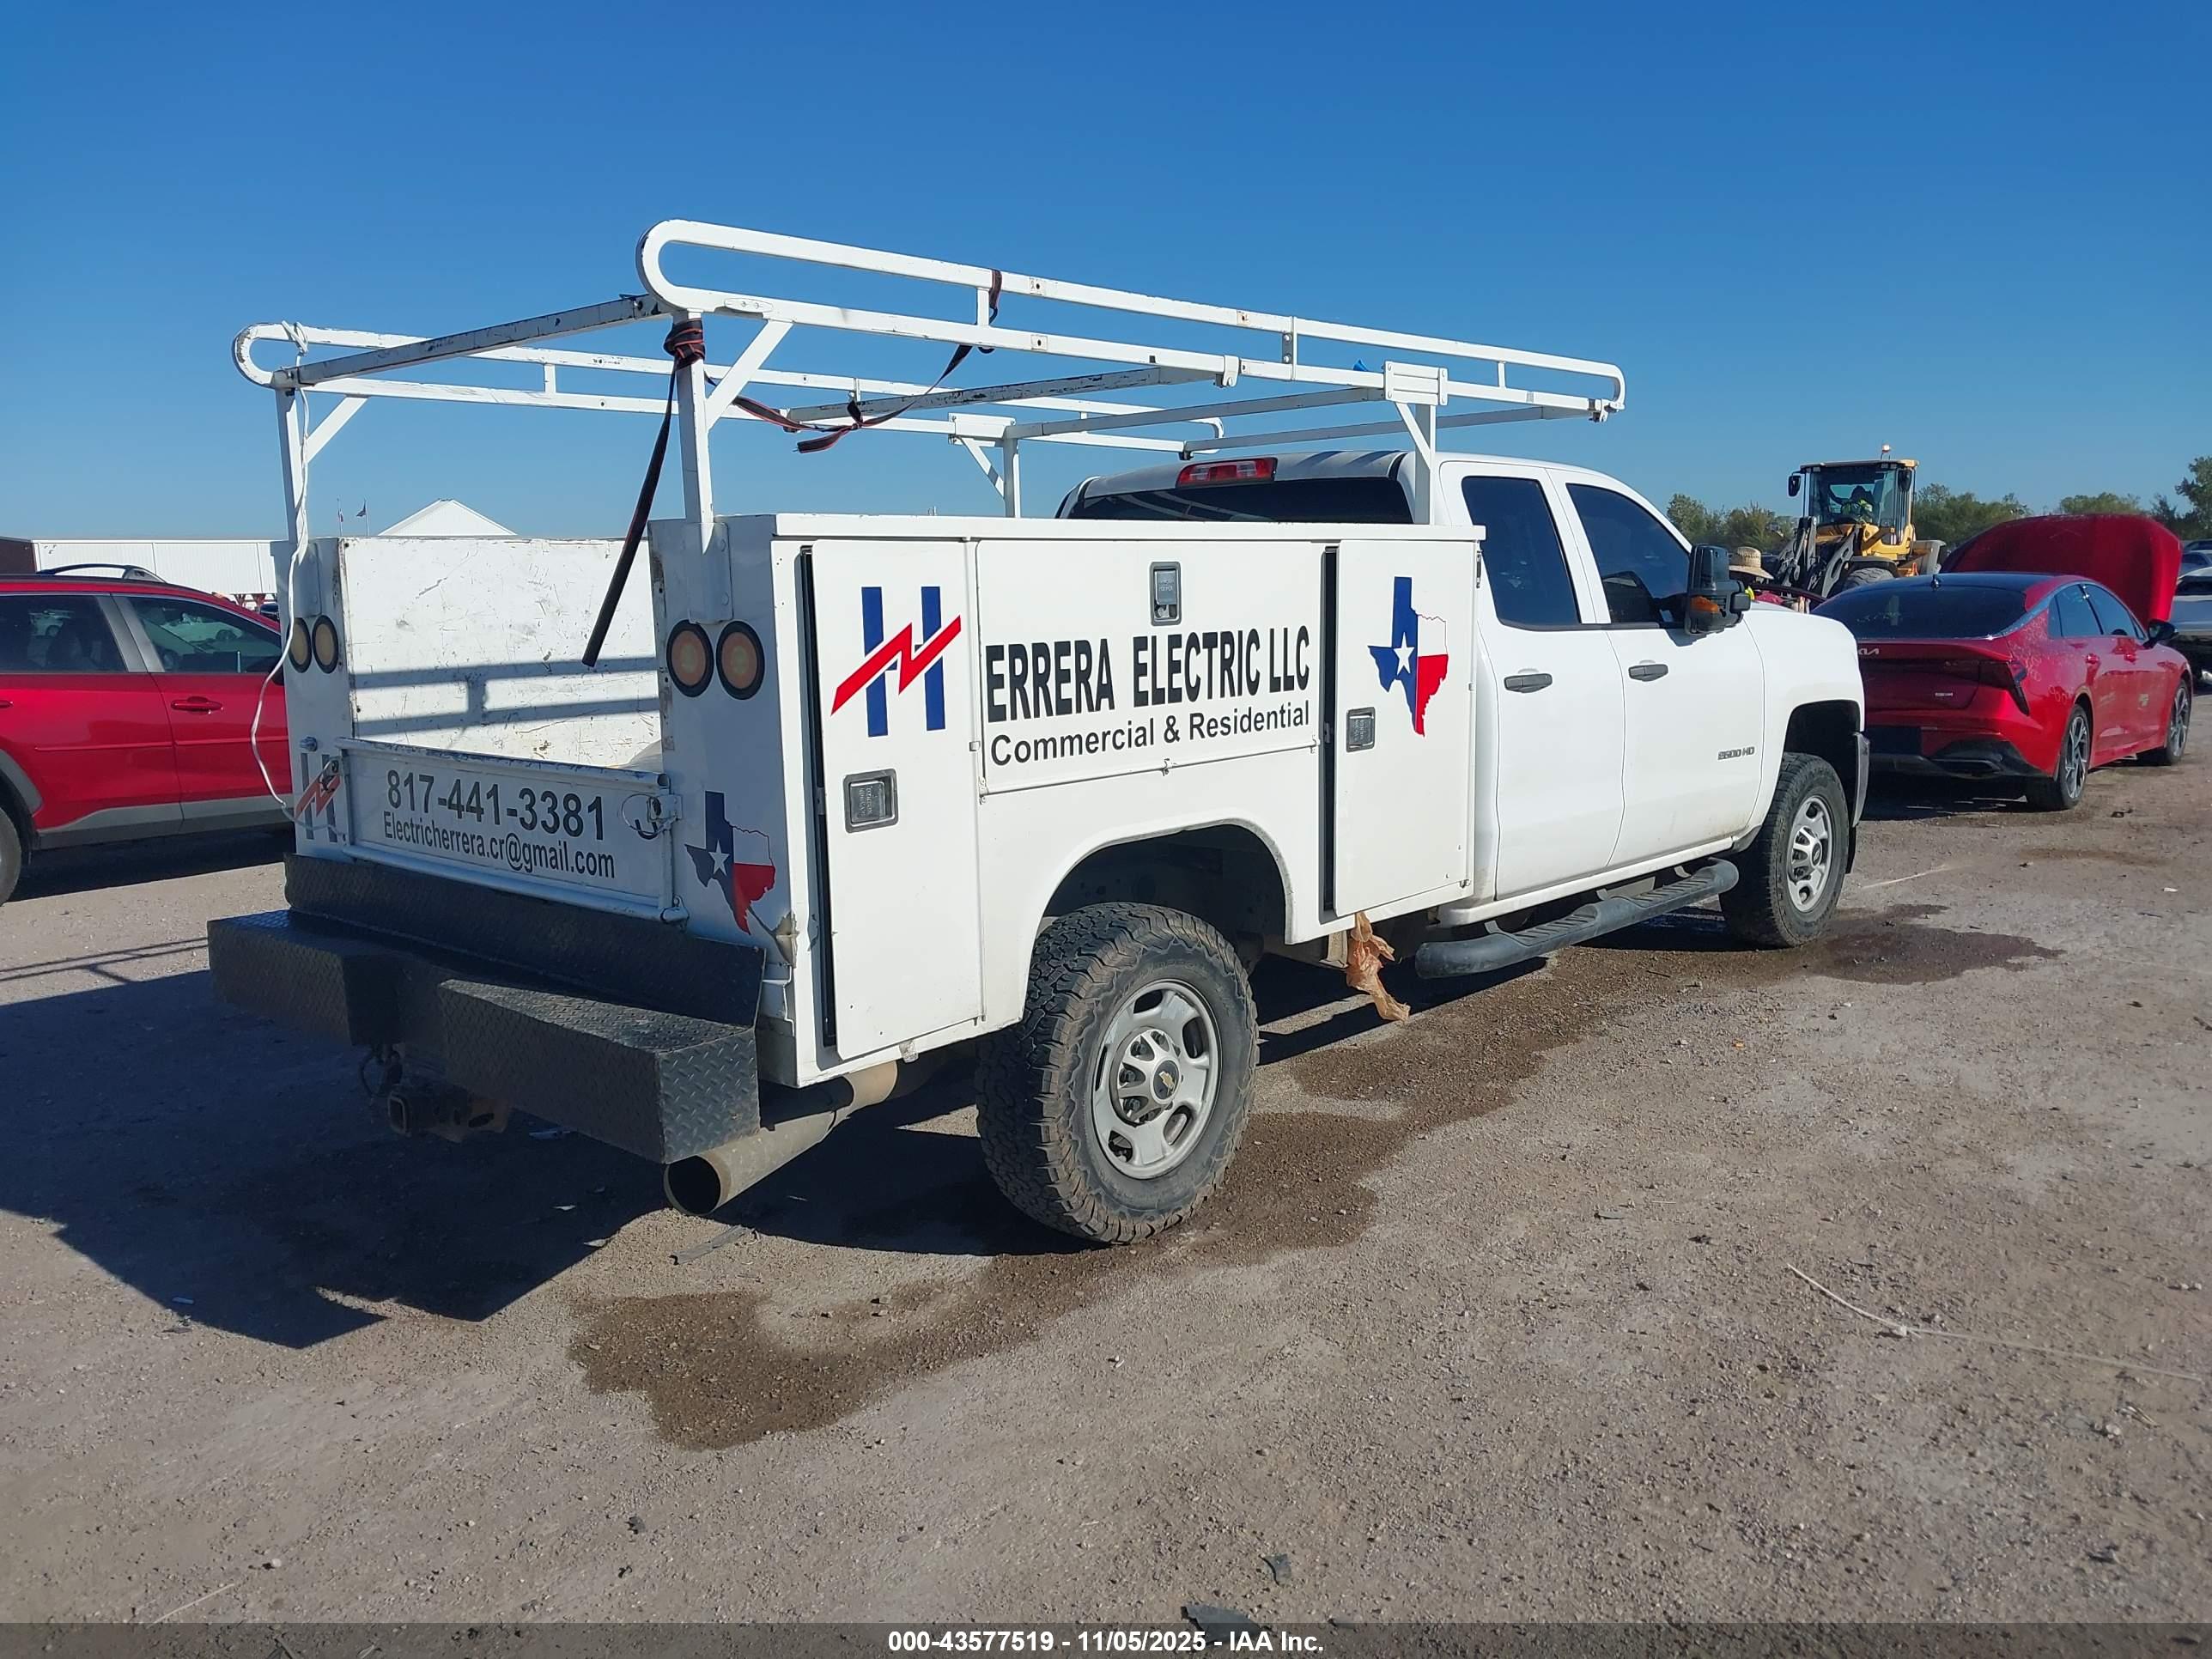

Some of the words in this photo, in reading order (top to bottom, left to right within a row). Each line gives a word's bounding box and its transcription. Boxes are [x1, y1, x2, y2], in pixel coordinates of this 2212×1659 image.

[985, 638, 1115, 723] ERRERA
[1133, 629, 1261, 708] ELECTRIC
[1268, 625, 1310, 694] LLC
[990, 717, 1154, 766] Commercial
[1163, 714, 1181, 744] &
[1188, 699, 1310, 741] Residential
[1742, 746, 1755, 756] HD
[386, 769, 604, 841] 817-441-3381
[383, 811, 616, 879] Electricherrera.cr@gmail.com
